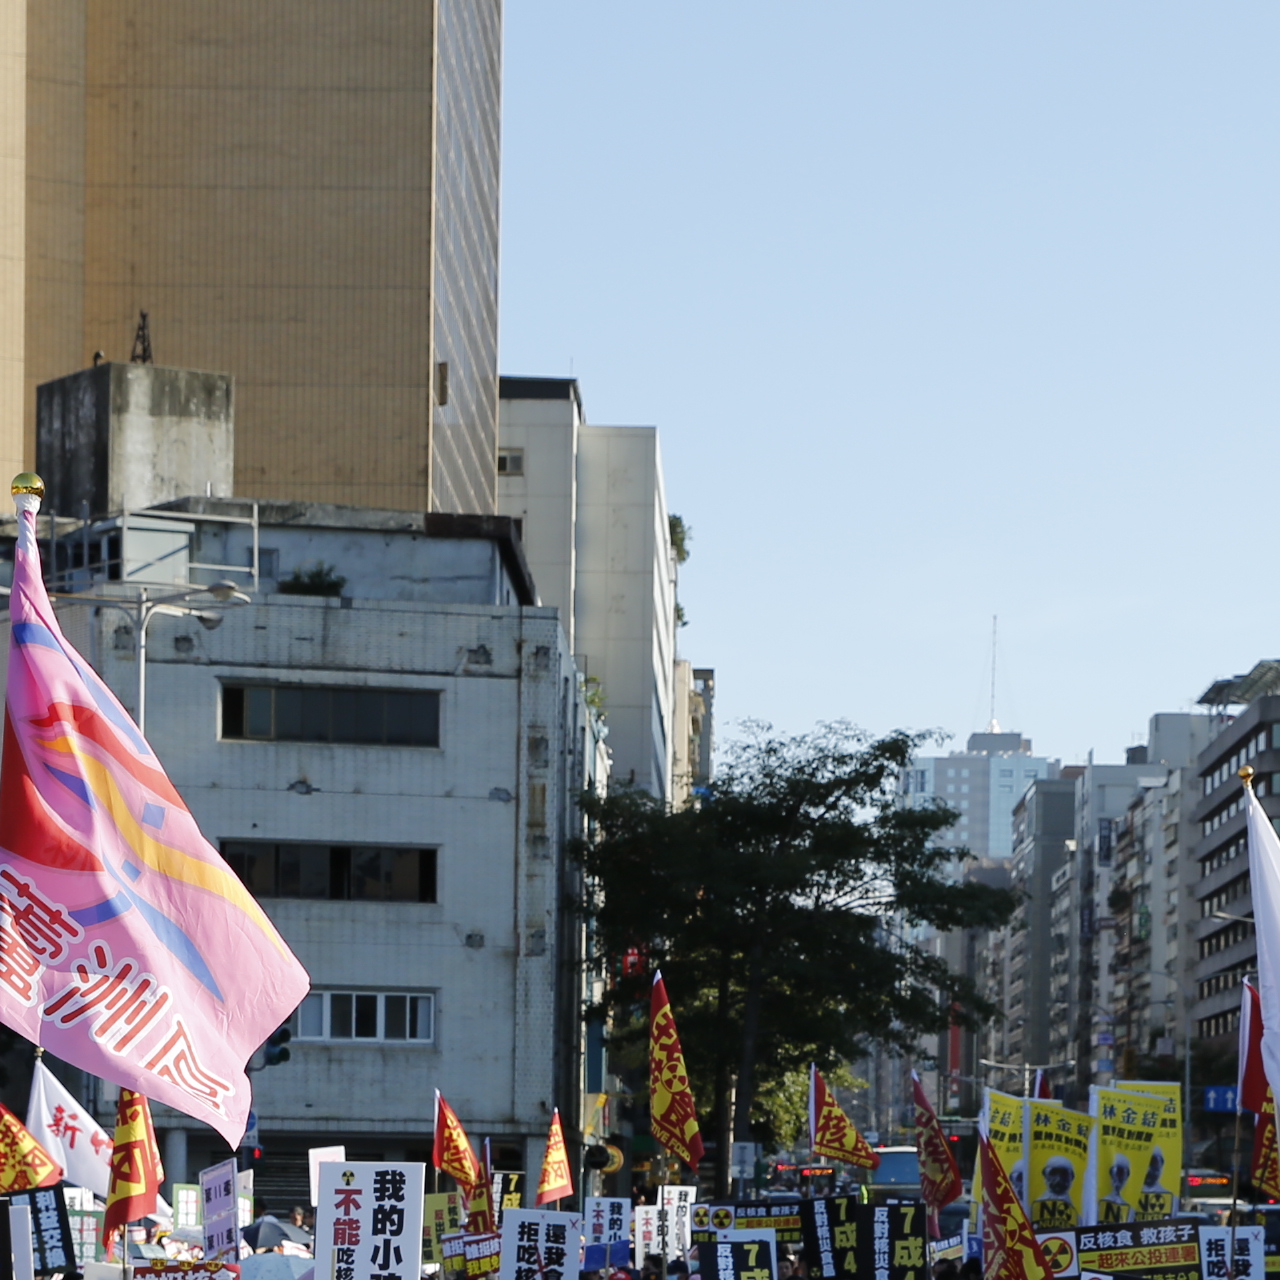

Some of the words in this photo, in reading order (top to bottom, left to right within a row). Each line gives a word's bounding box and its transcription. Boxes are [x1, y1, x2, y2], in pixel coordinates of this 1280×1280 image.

[1033, 1112, 1091, 1139] 林金結
[1102, 1103, 1160, 1128] 林金結
[813, 1199, 837, 1278] 反對核災食品
[833, 1197, 858, 1275] 7成4
[1079, 1229, 1134, 1250] 反核食
[1140, 1224, 1196, 1246] 救孩子
[1080, 1245, 1198, 1271] 一起來公投連署
